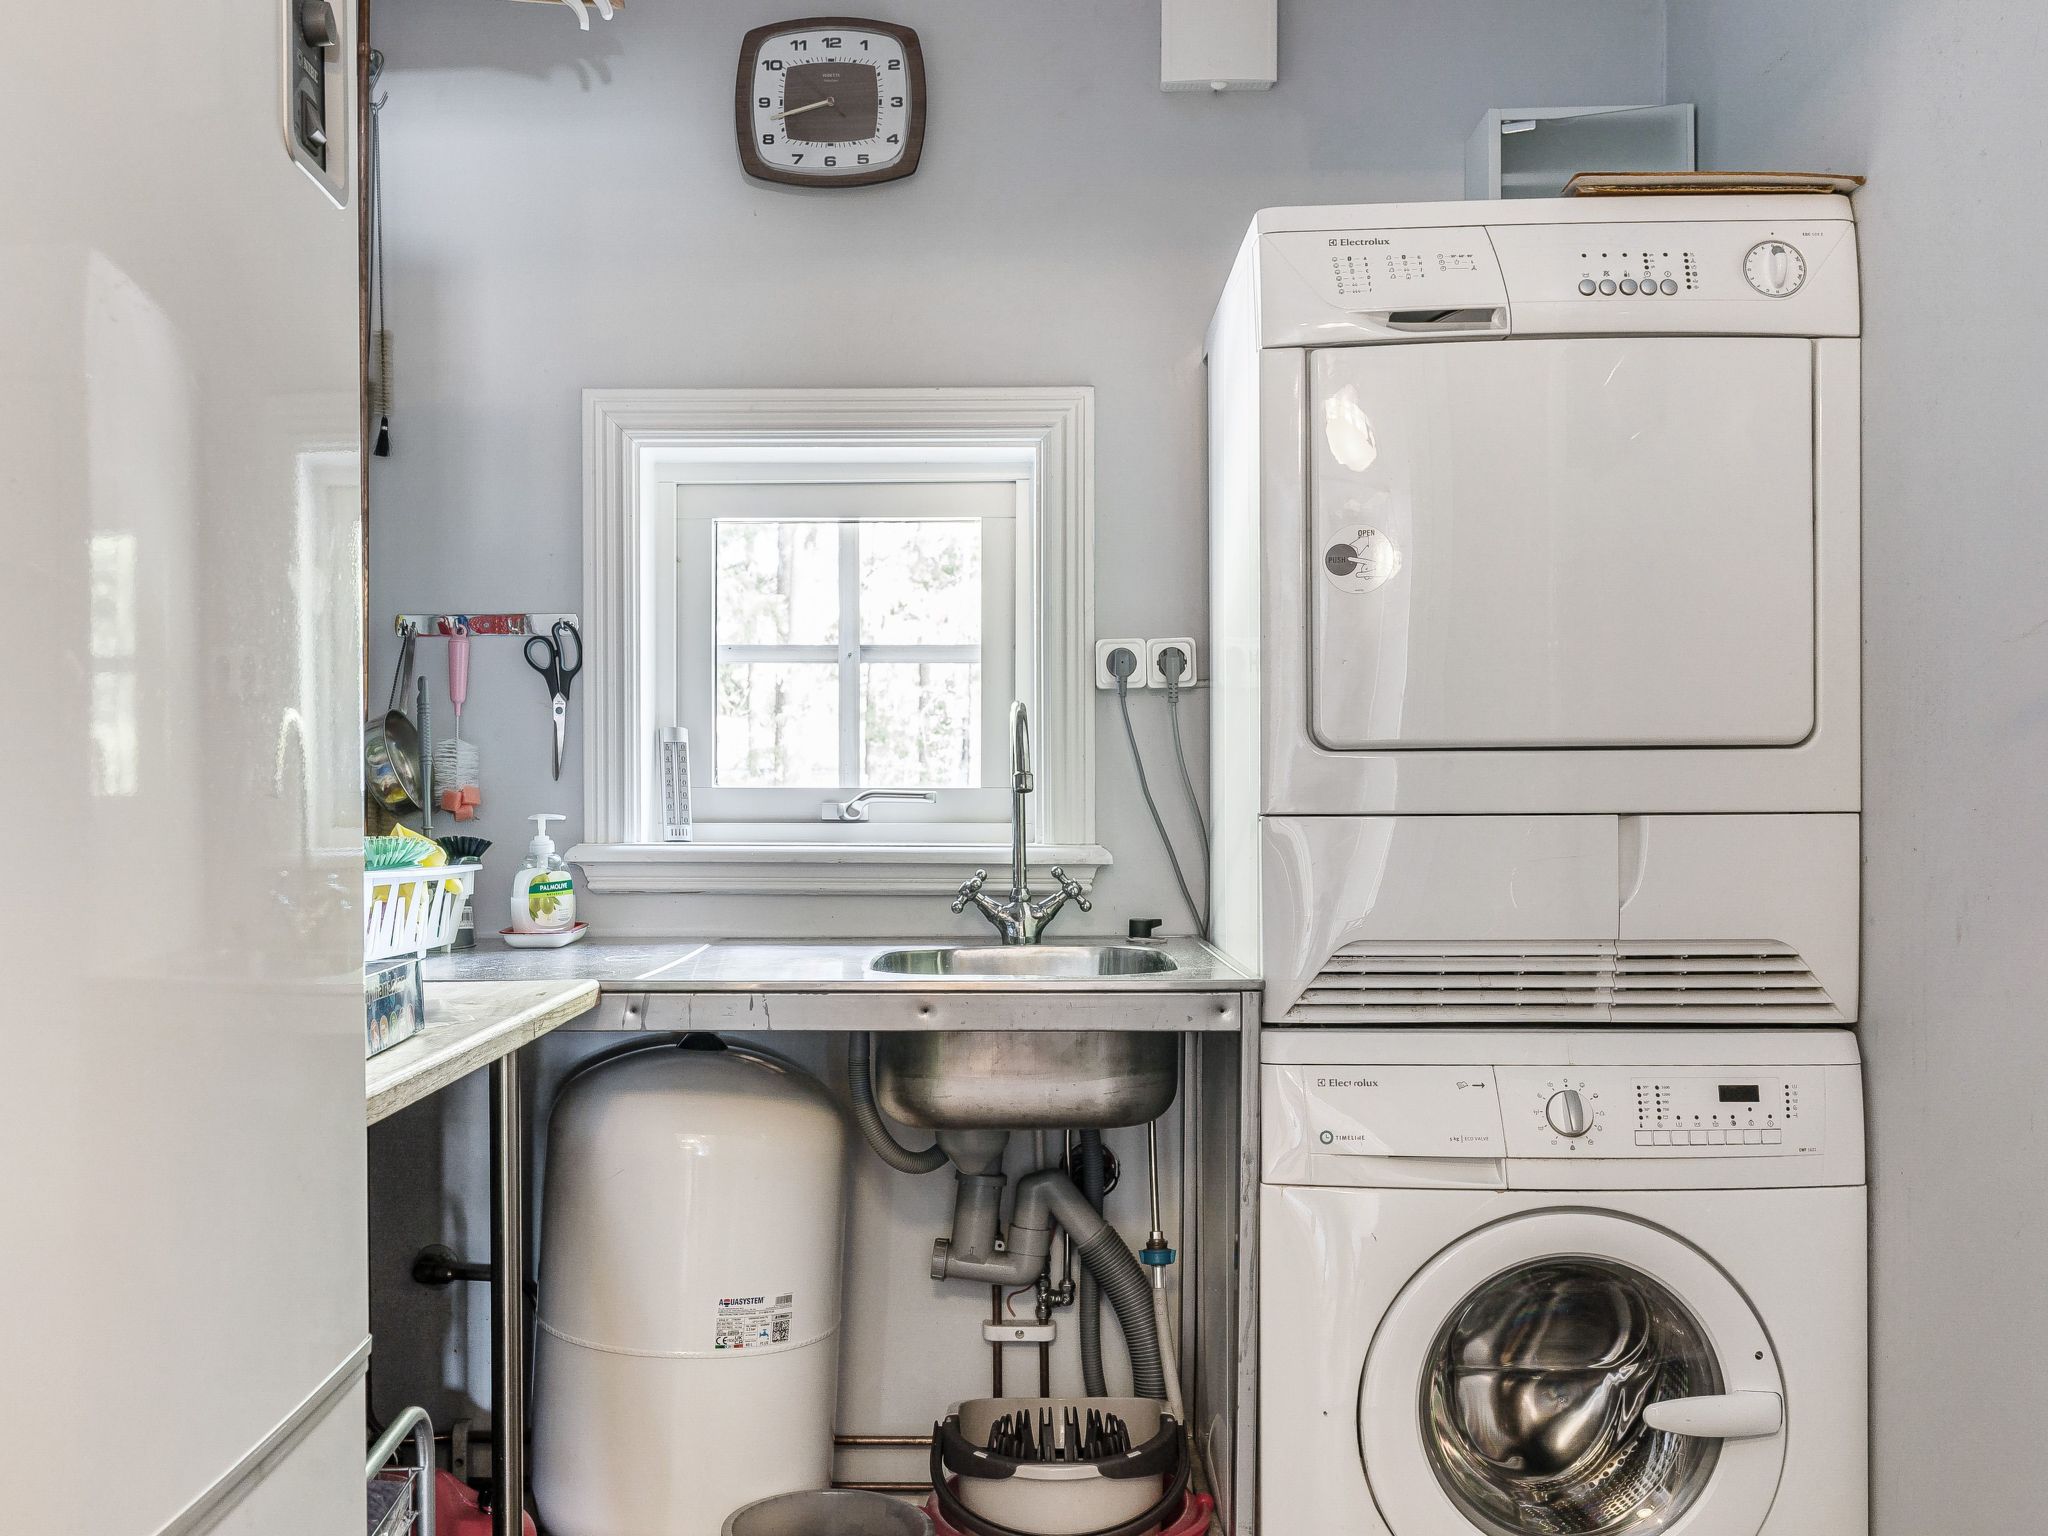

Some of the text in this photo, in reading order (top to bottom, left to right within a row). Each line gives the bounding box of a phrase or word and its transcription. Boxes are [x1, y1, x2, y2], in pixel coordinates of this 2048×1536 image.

[790, 40, 806, 51] 11
[822, 38, 841, 48] 12
[860, 40, 868, 50] 1
[762, 60, 782, 70] 10
[888, 60, 900, 70] 2
[759, 97, 770, 108] 9
[891, 97, 903, 108] 3
[762, 134, 774, 144] 8
[887, 134, 899, 144] 4
[792, 154, 804, 164] 7
[824, 156, 836, 166] 6
[857, 154, 869, 164] 5
[1340, 238, 1390, 246] Electrolux
[539, 882, 568, 891] PALMOLIVE
